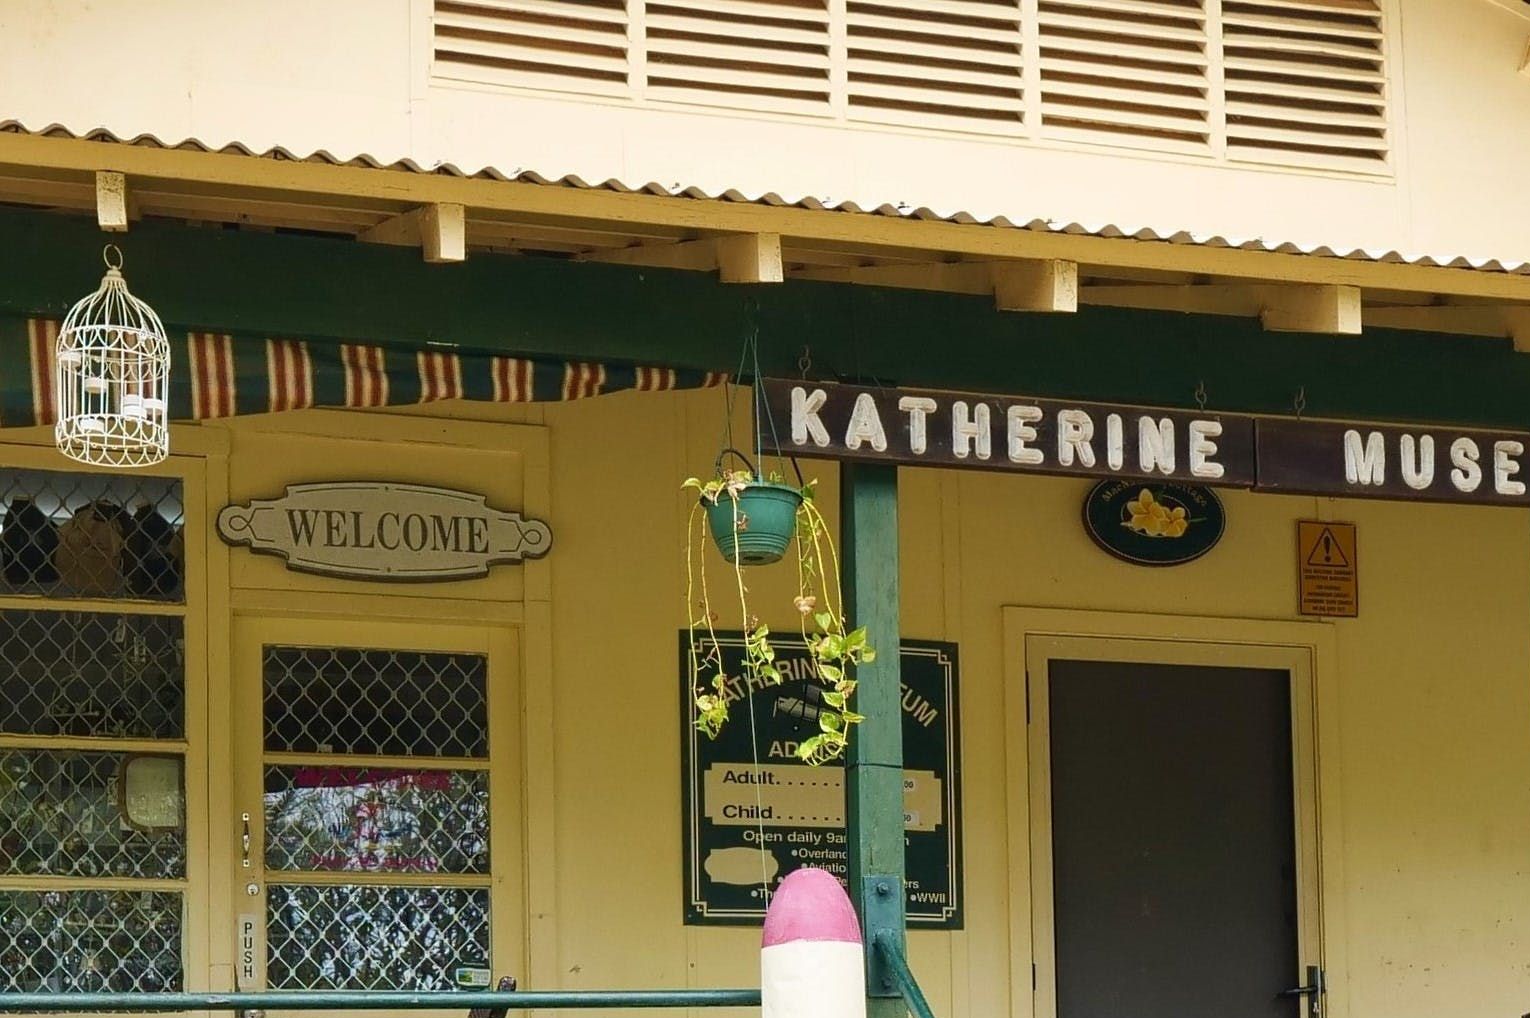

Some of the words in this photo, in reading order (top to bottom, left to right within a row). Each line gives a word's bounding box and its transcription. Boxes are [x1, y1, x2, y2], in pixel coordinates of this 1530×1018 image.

[791, 386, 1225, 479] KATHERINE
[285, 508, 490, 555] WELCOME
[743, 829, 783, 845] Open
[787, 832, 822, 845] daily
[808, 862, 847, 873] Aviatio
[917, 892, 946, 903] WWII
[243, 921, 254, 978] PUSH
